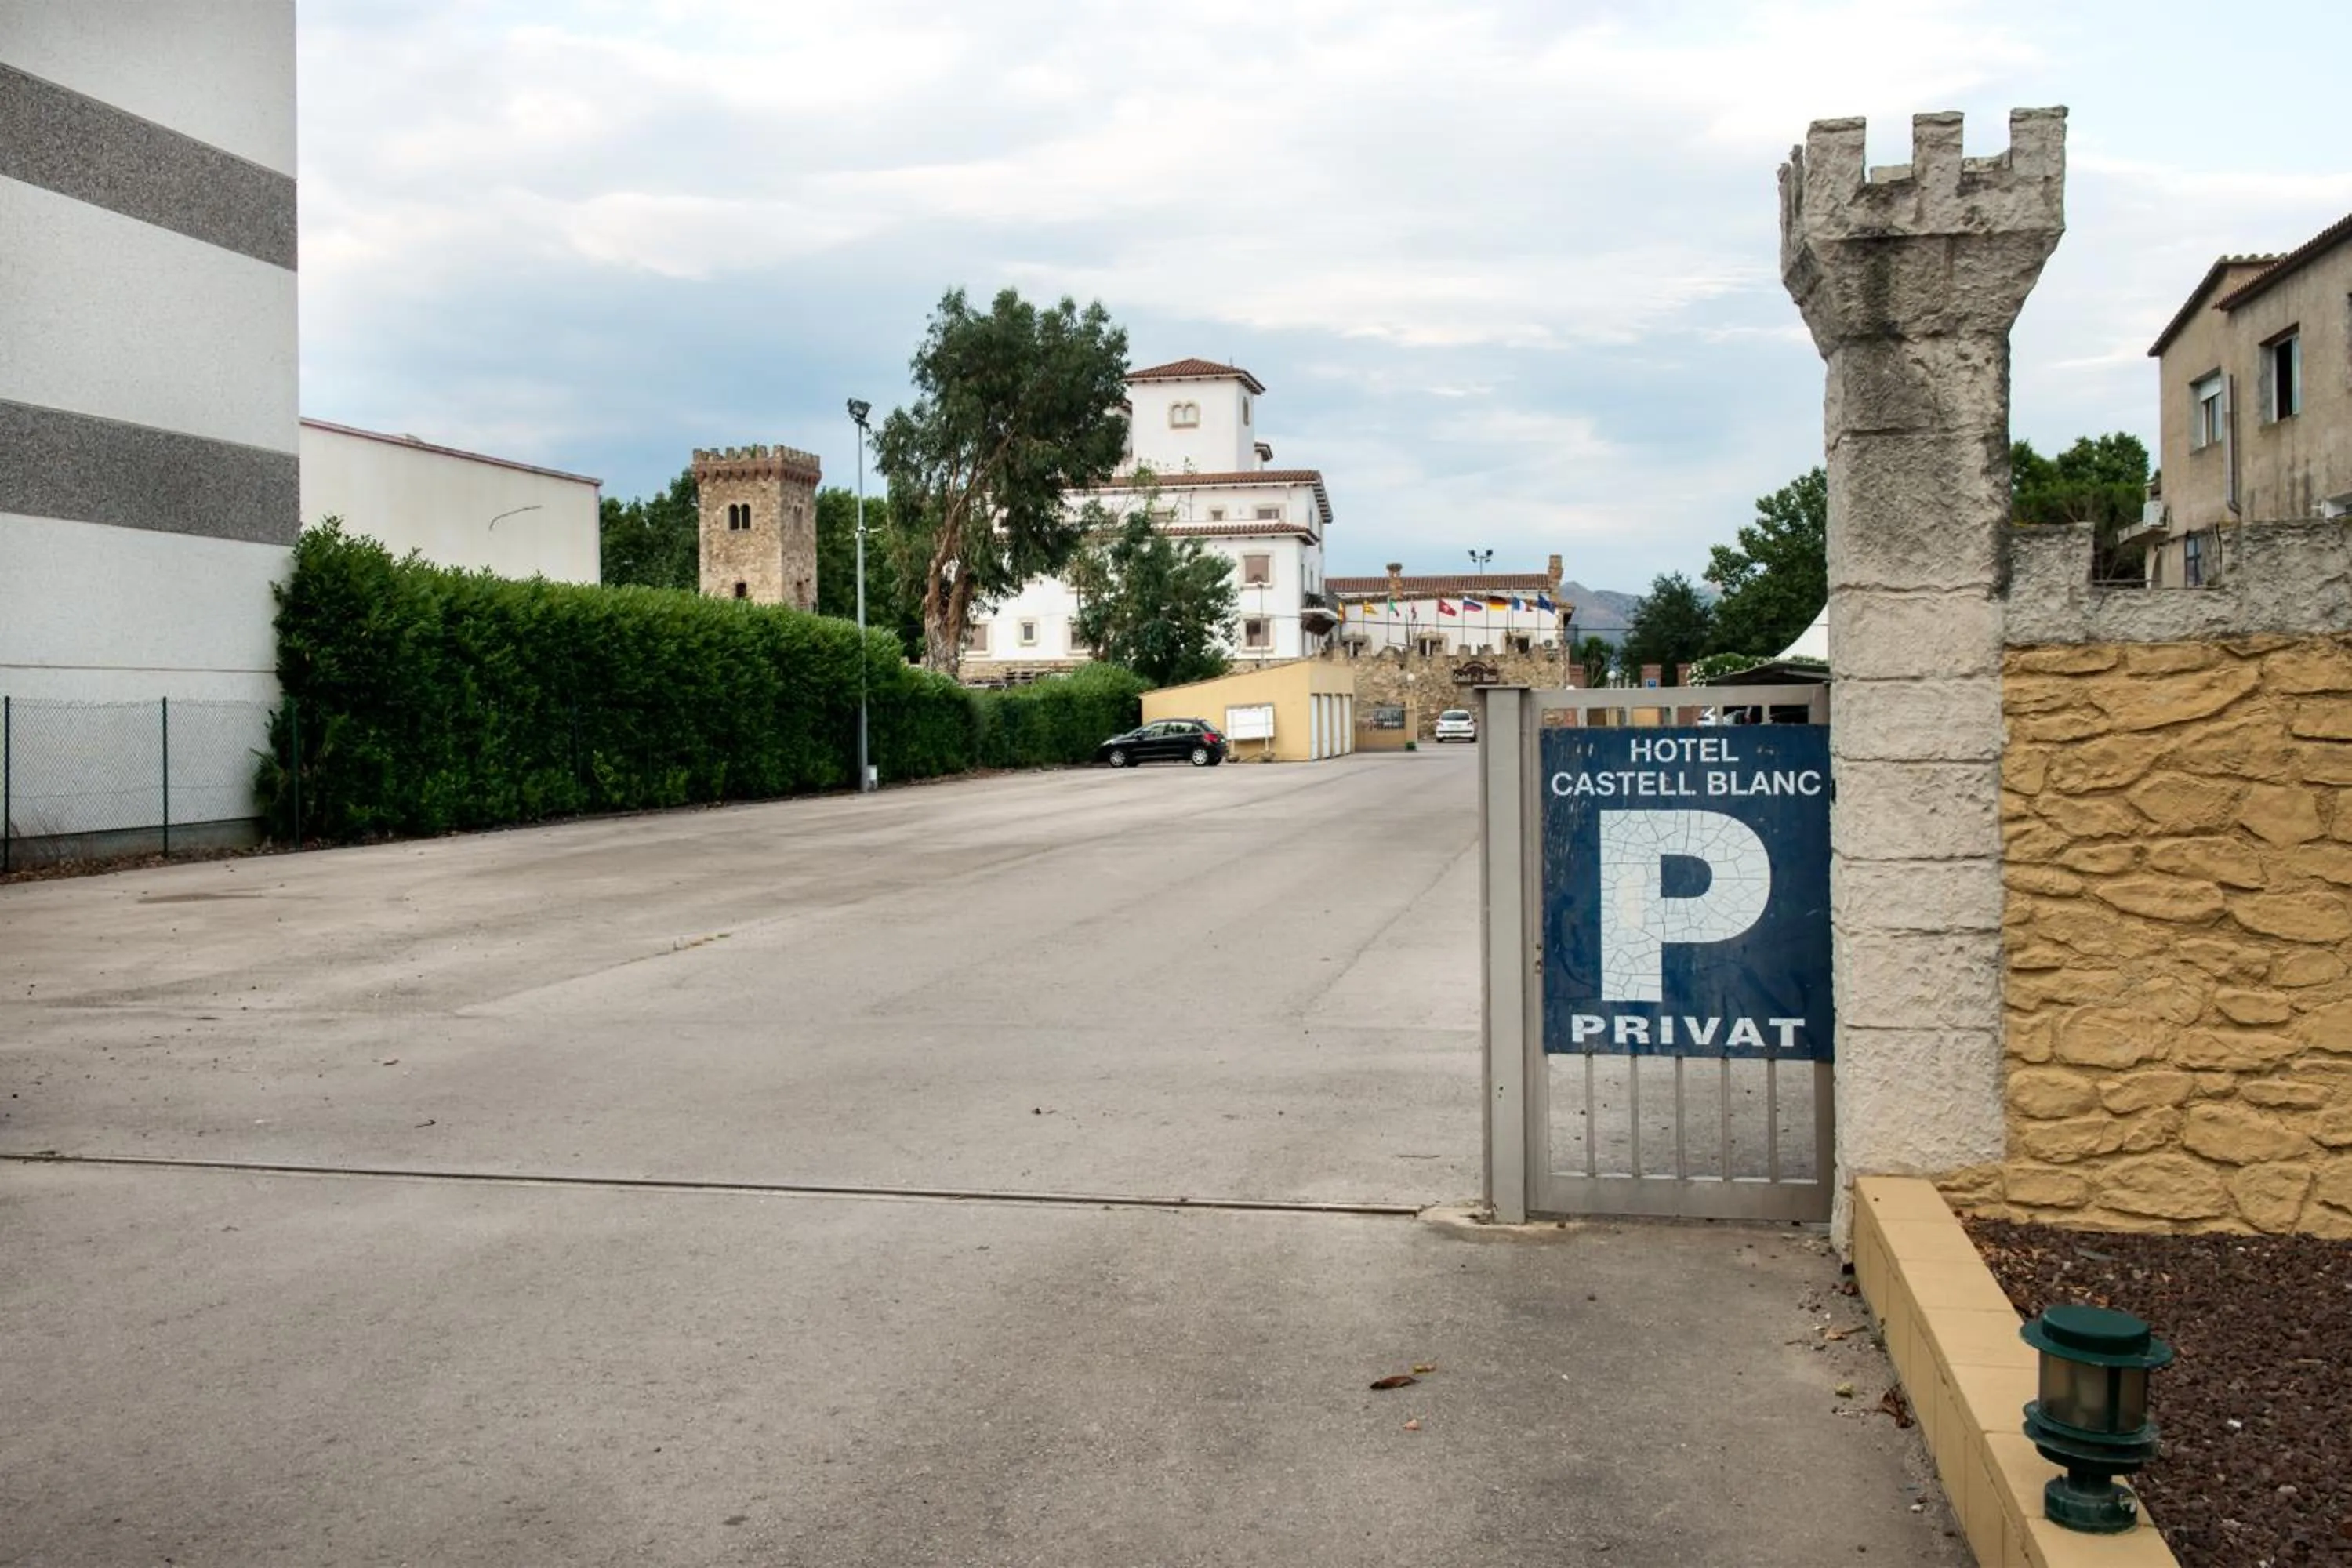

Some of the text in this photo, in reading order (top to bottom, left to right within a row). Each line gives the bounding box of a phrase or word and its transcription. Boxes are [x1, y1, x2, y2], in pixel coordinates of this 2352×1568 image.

[1630, 738, 1740, 763] HOTEL
[1551, 770, 1821, 796] CASTELL BLANC
[1599, 808, 1771, 1003] P
[1571, 1014, 1806, 1047] PRIVAT
